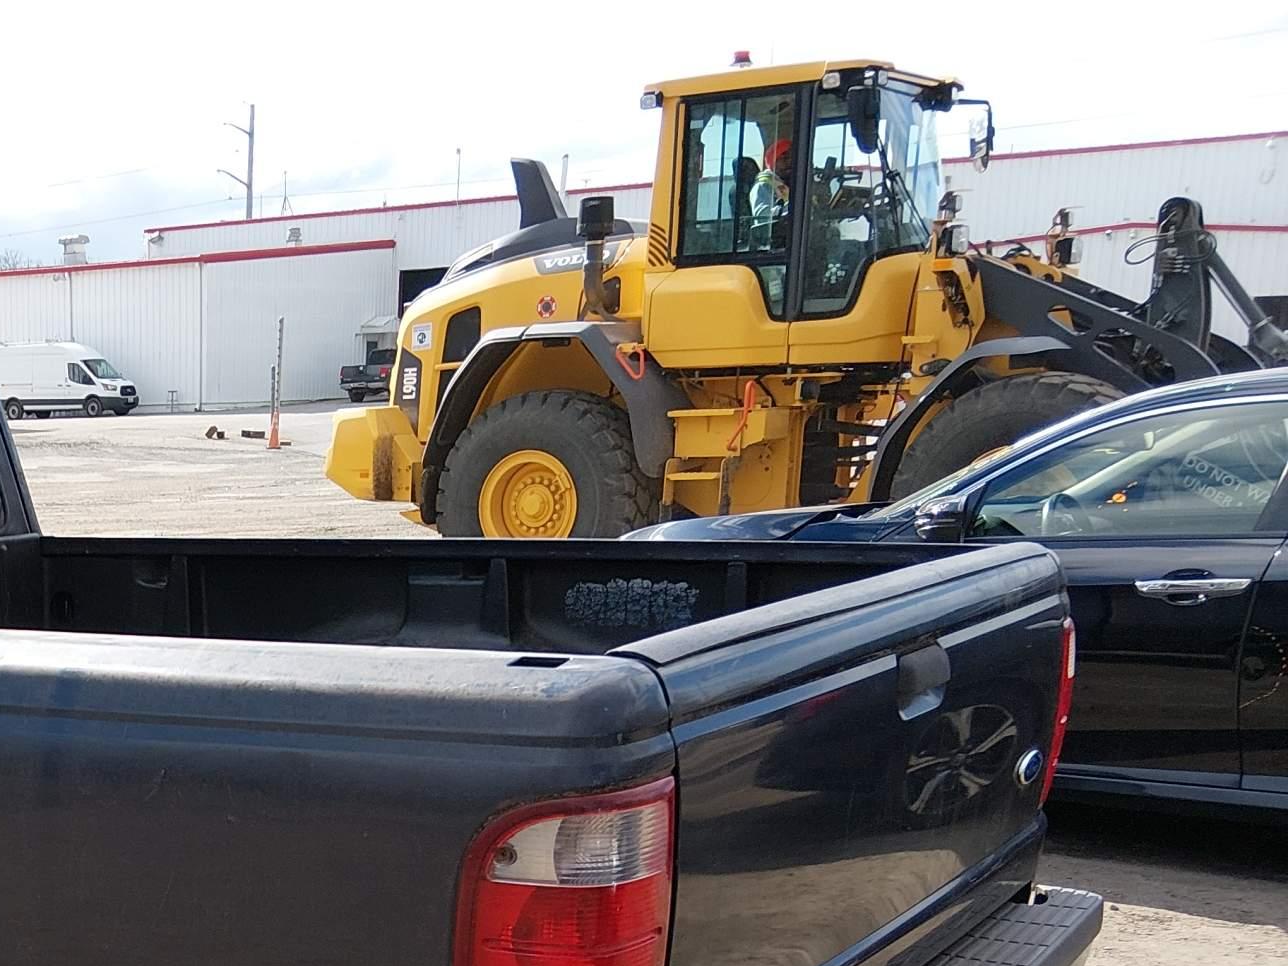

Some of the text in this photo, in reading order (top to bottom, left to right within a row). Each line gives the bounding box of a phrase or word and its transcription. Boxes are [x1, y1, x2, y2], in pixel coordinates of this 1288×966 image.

[402, 367, 418, 400] L90H
[1184, 456, 1209, 474] DO
[1209, 465, 1243, 491] NOT
[1183, 475, 1233, 508] UNDER
